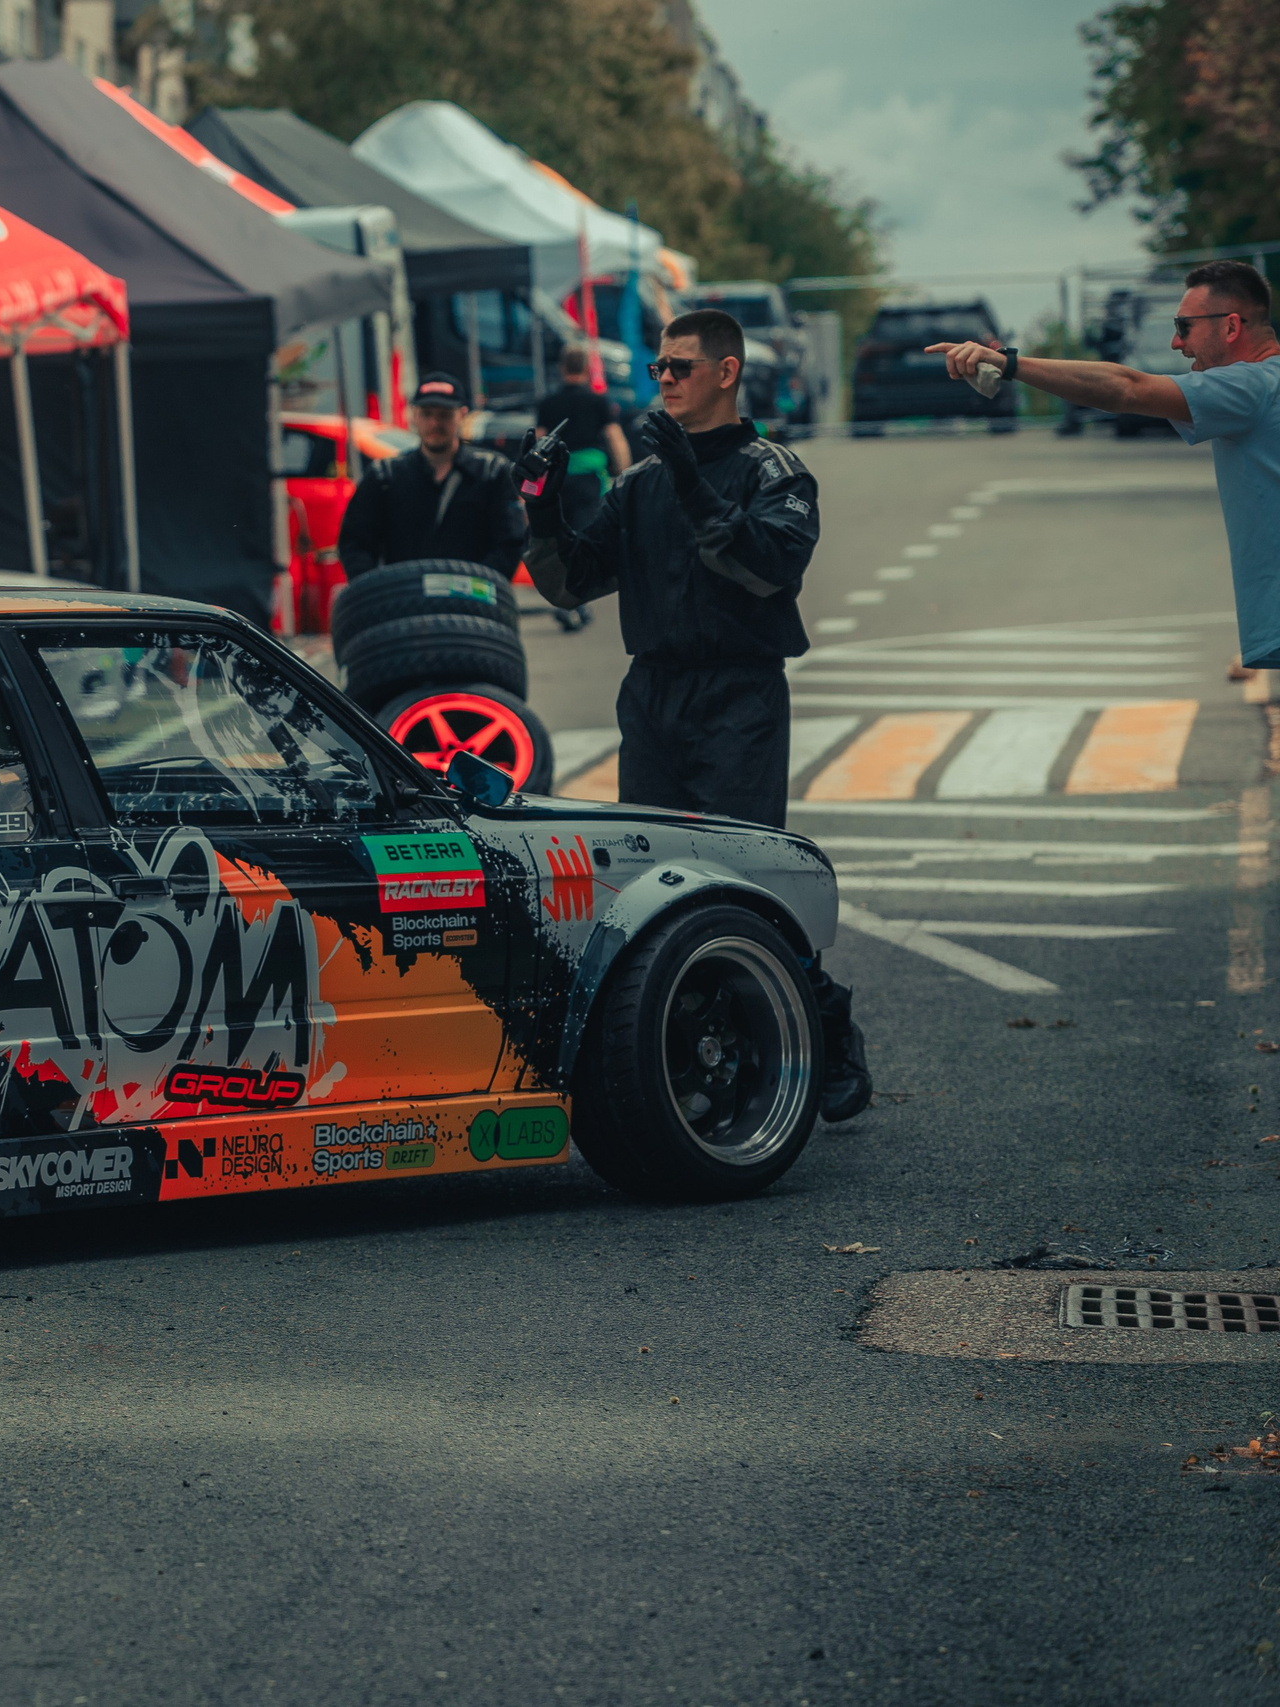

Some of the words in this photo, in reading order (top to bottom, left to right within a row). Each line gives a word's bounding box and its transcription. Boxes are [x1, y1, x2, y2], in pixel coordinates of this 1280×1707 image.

[384, 878, 480, 900] RACING.BY
[392, 914, 468, 930] Blockchain
[393, 932, 441, 950] Sports
[171, 1072, 299, 1101] GROUP
[314, 1119, 425, 1146] Blockchain
[507, 1119, 556, 1146] LABS
[222, 1133, 284, 1157] NEURO
[222, 1154, 283, 1176] DESIGN
[313, 1147, 383, 1176] Sports
[392, 1149, 429, 1165] DRIFT
[56, 1183, 95, 1198] MSPORT
[96, 1180, 132, 1195] DESIGN
